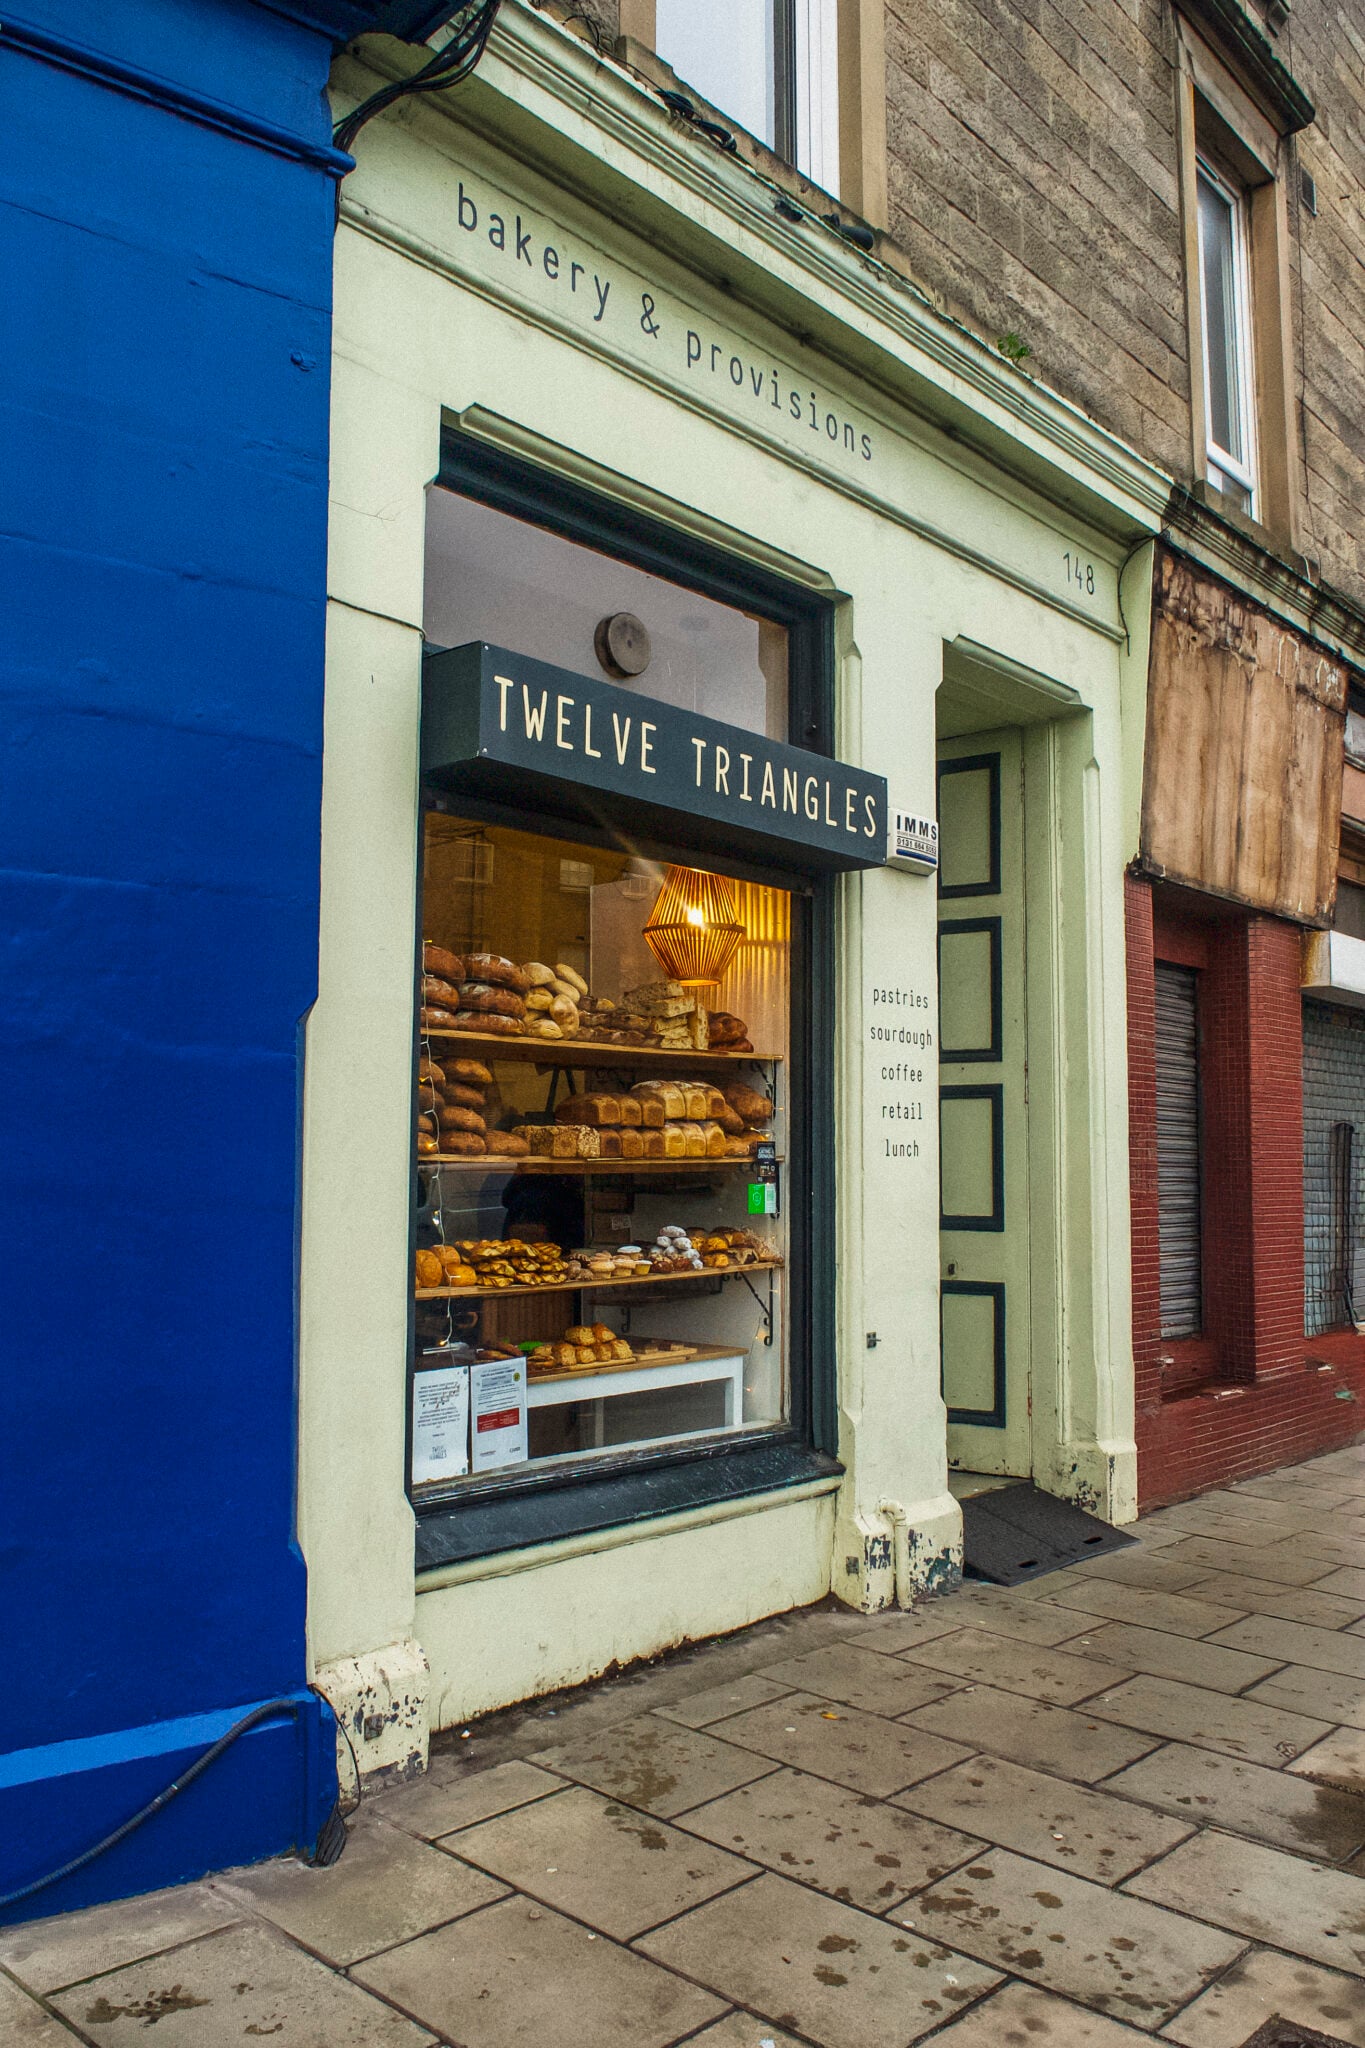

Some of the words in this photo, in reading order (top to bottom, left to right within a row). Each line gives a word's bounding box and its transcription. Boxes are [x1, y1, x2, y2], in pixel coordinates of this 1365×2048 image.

[458, 182, 610, 322] bakery
[640, 293, 660, 339] &
[687, 330, 872, 461] provisions
[1063, 552, 1095, 595] 148
[494, 675, 657, 774] TWELVE
[691, 737, 877, 838] TRIANGLES
[897, 815, 936, 840] IMMS
[873, 988, 929, 1009] pastries
[870, 1026, 932, 1050] sourdough
[881, 1063, 923, 1082] coffee
[882, 1102, 923, 1120] retail
[885, 1138, 919, 1157] lunch
